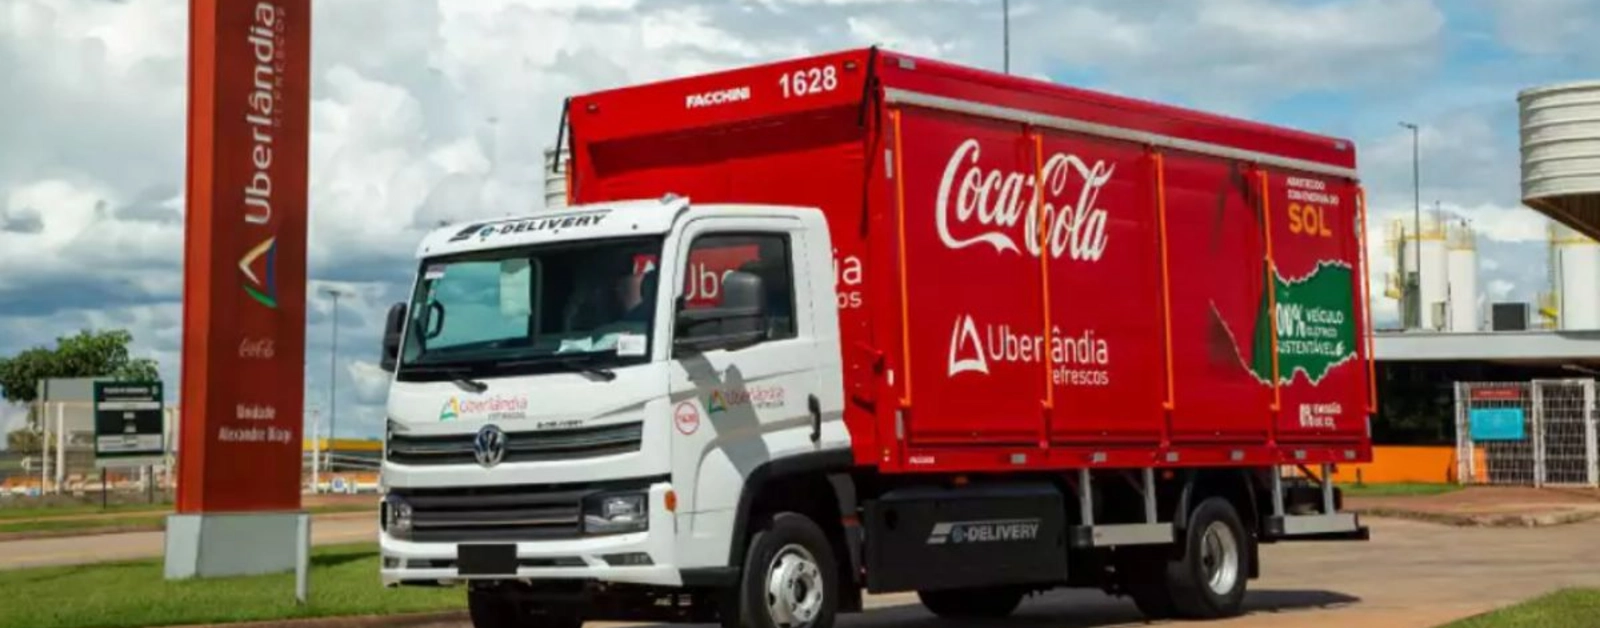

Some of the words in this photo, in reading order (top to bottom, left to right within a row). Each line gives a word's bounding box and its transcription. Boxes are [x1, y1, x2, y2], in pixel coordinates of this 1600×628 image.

[779, 65, 837, 98] 1628
[685, 86, 751, 109] FACCHINI
[244, 2, 275, 225] Uberlândia
[1288, 202, 1332, 237] SOL
[1305, 307, 1344, 324] VEÍCULO
[987, 324, 1109, 365] Uberândia
[1051, 364, 1109, 385] efrescos
[459, 397, 528, 413] Uberlândia
[951, 523, 1039, 543] e-DELIVERY
